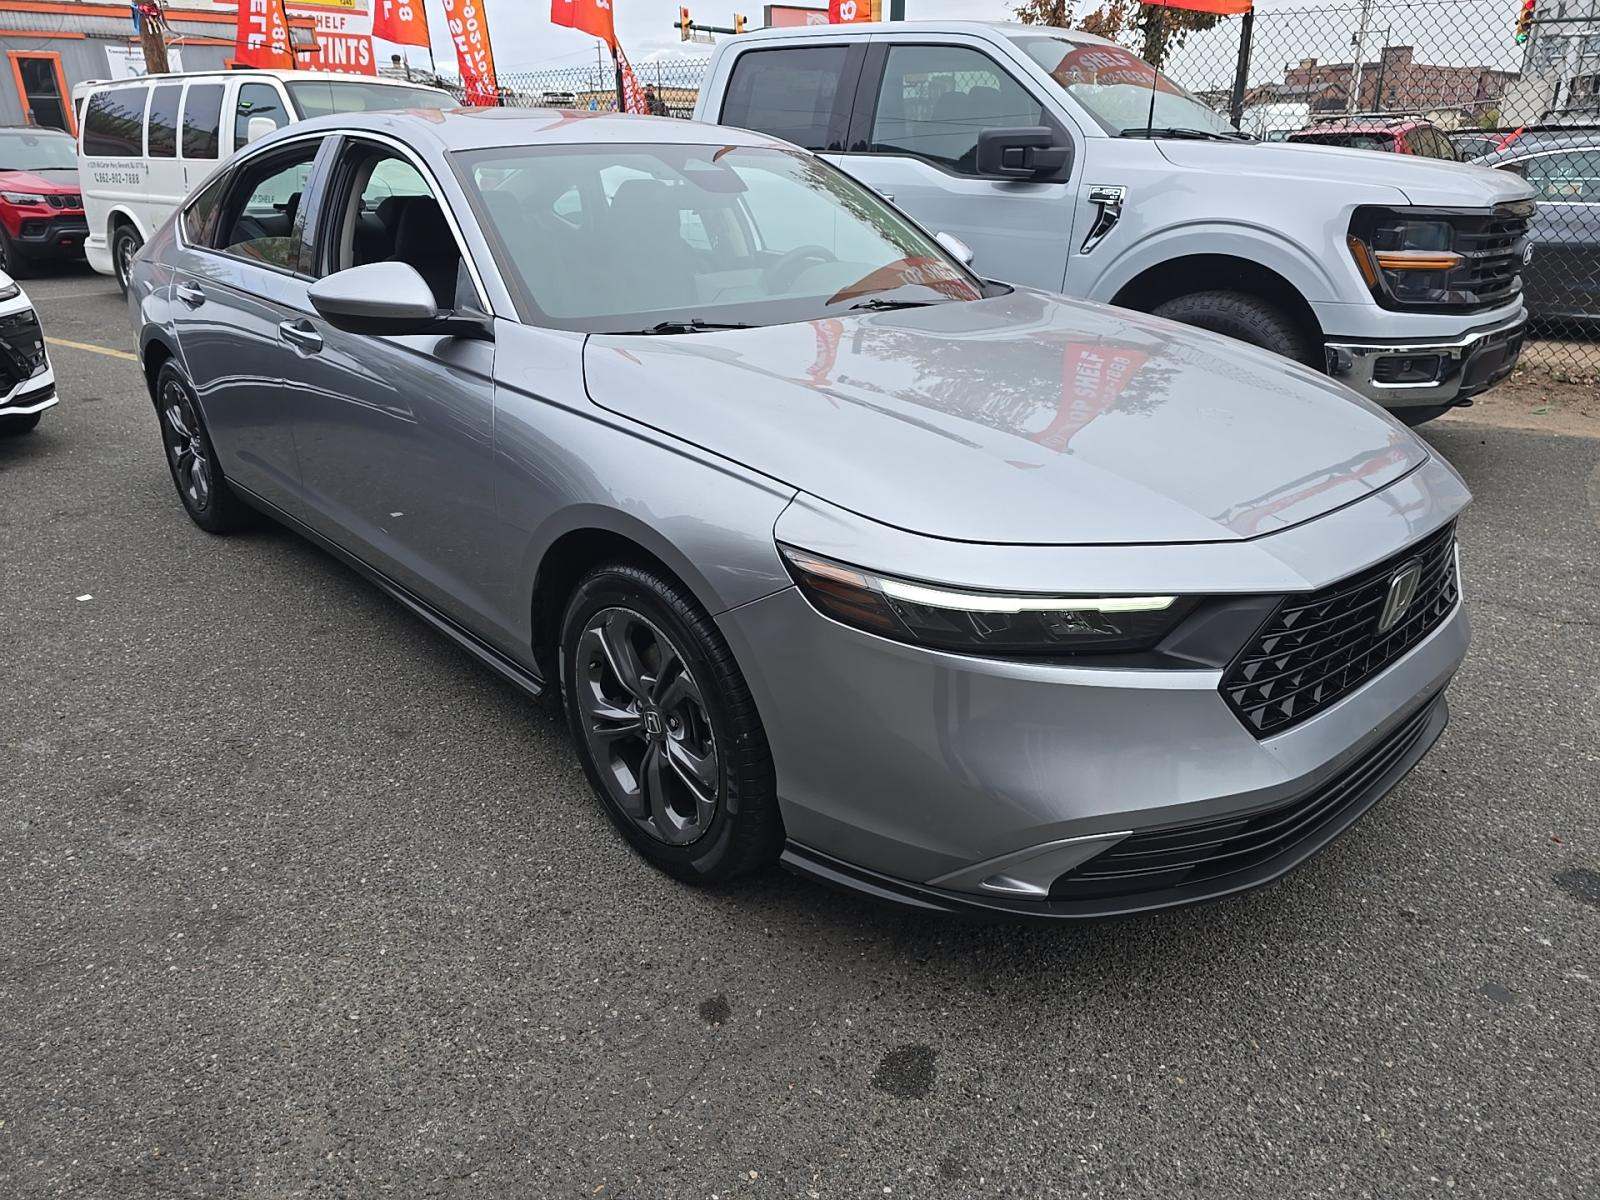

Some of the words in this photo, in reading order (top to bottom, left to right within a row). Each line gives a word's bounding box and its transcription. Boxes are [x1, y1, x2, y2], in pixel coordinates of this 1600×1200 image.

[309, 14, 346, 30] HELF
[317, 36, 370, 66] TINTS
[1072, 350, 1104, 399] SHELF
